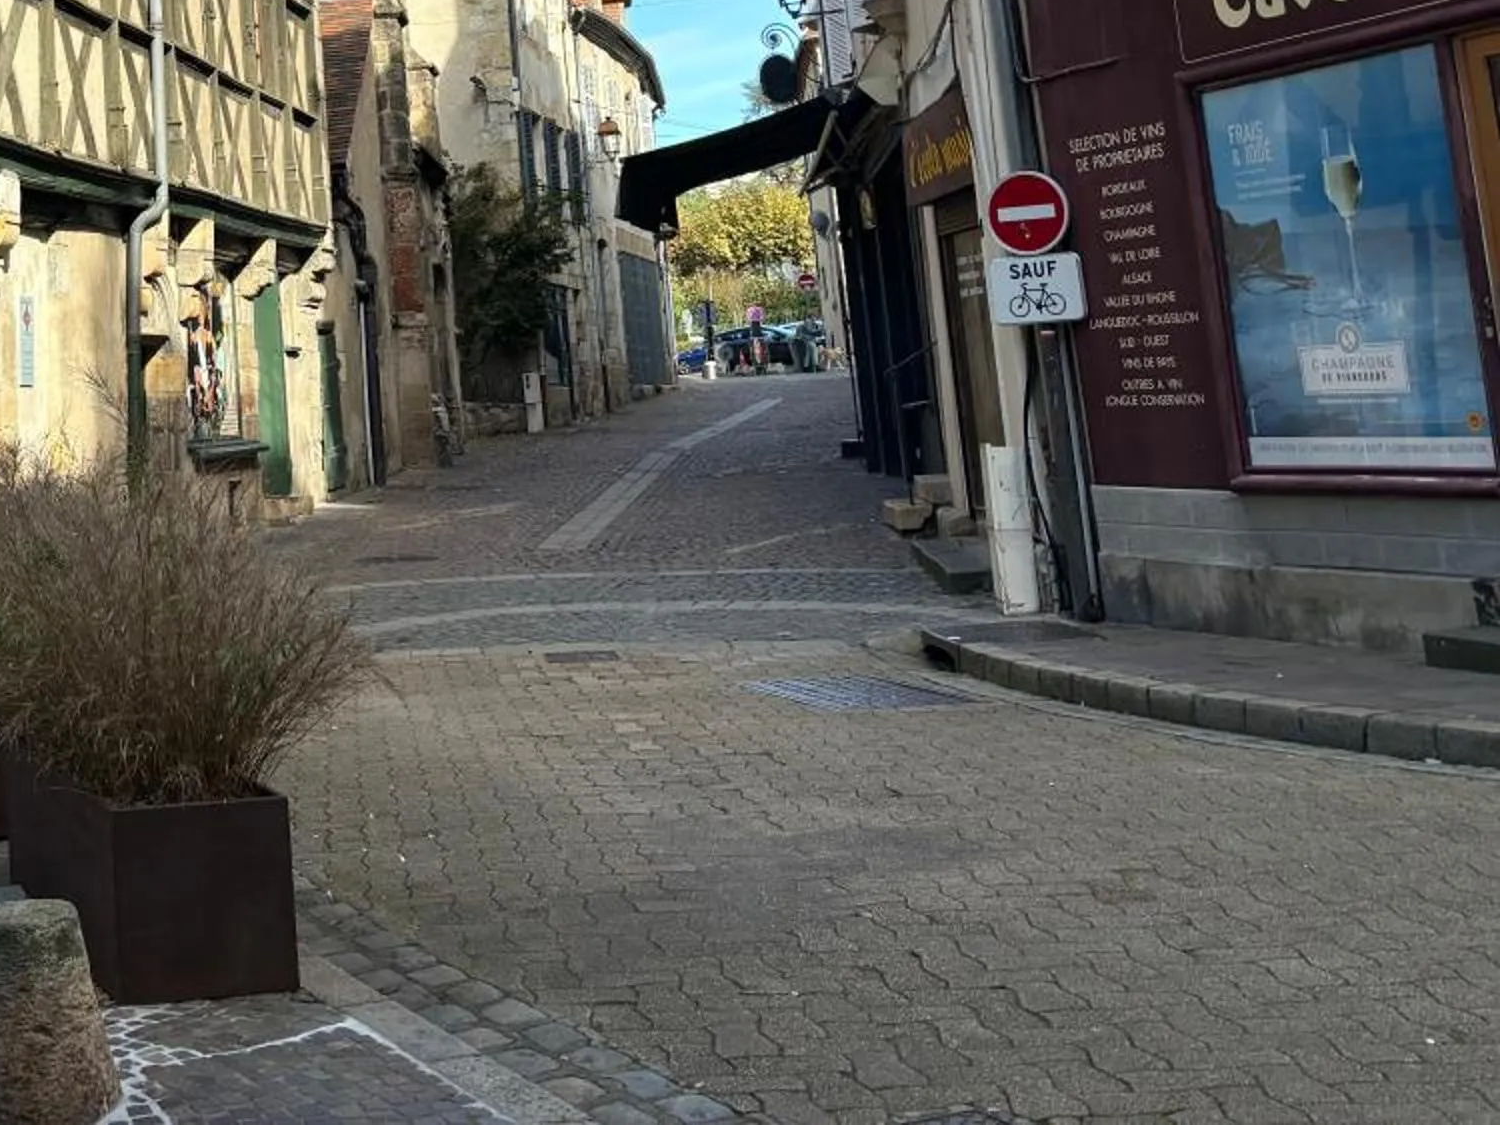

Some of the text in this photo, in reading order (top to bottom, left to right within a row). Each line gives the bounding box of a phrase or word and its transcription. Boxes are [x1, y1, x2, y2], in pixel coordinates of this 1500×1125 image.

[1069, 122, 1166, 154] SELECTION DE VINS
[1075, 142, 1165, 173] DE PROPRIETAIRES
[1101, 179, 1146, 197] BORDEAUX
[1100, 201, 1154, 220] BOURGOGNE
[1103, 224, 1157, 243] CHAMPAGNE
[1109, 247, 1161, 264] VAL DE LOIRE
[1009, 260, 1057, 280] SAUF
[1122, 271, 1152, 284] ALSACE
[1132, 293, 1145, 306] DU
[1143, 334, 1170, 347] OUEST
[1122, 357, 1142, 370] VINS
[1143, 356, 1155, 369] DE
[1311, 354, 1395, 371] CHAMPAGNE
[1105, 393, 1205, 407] LONGUE CONSERVATION
